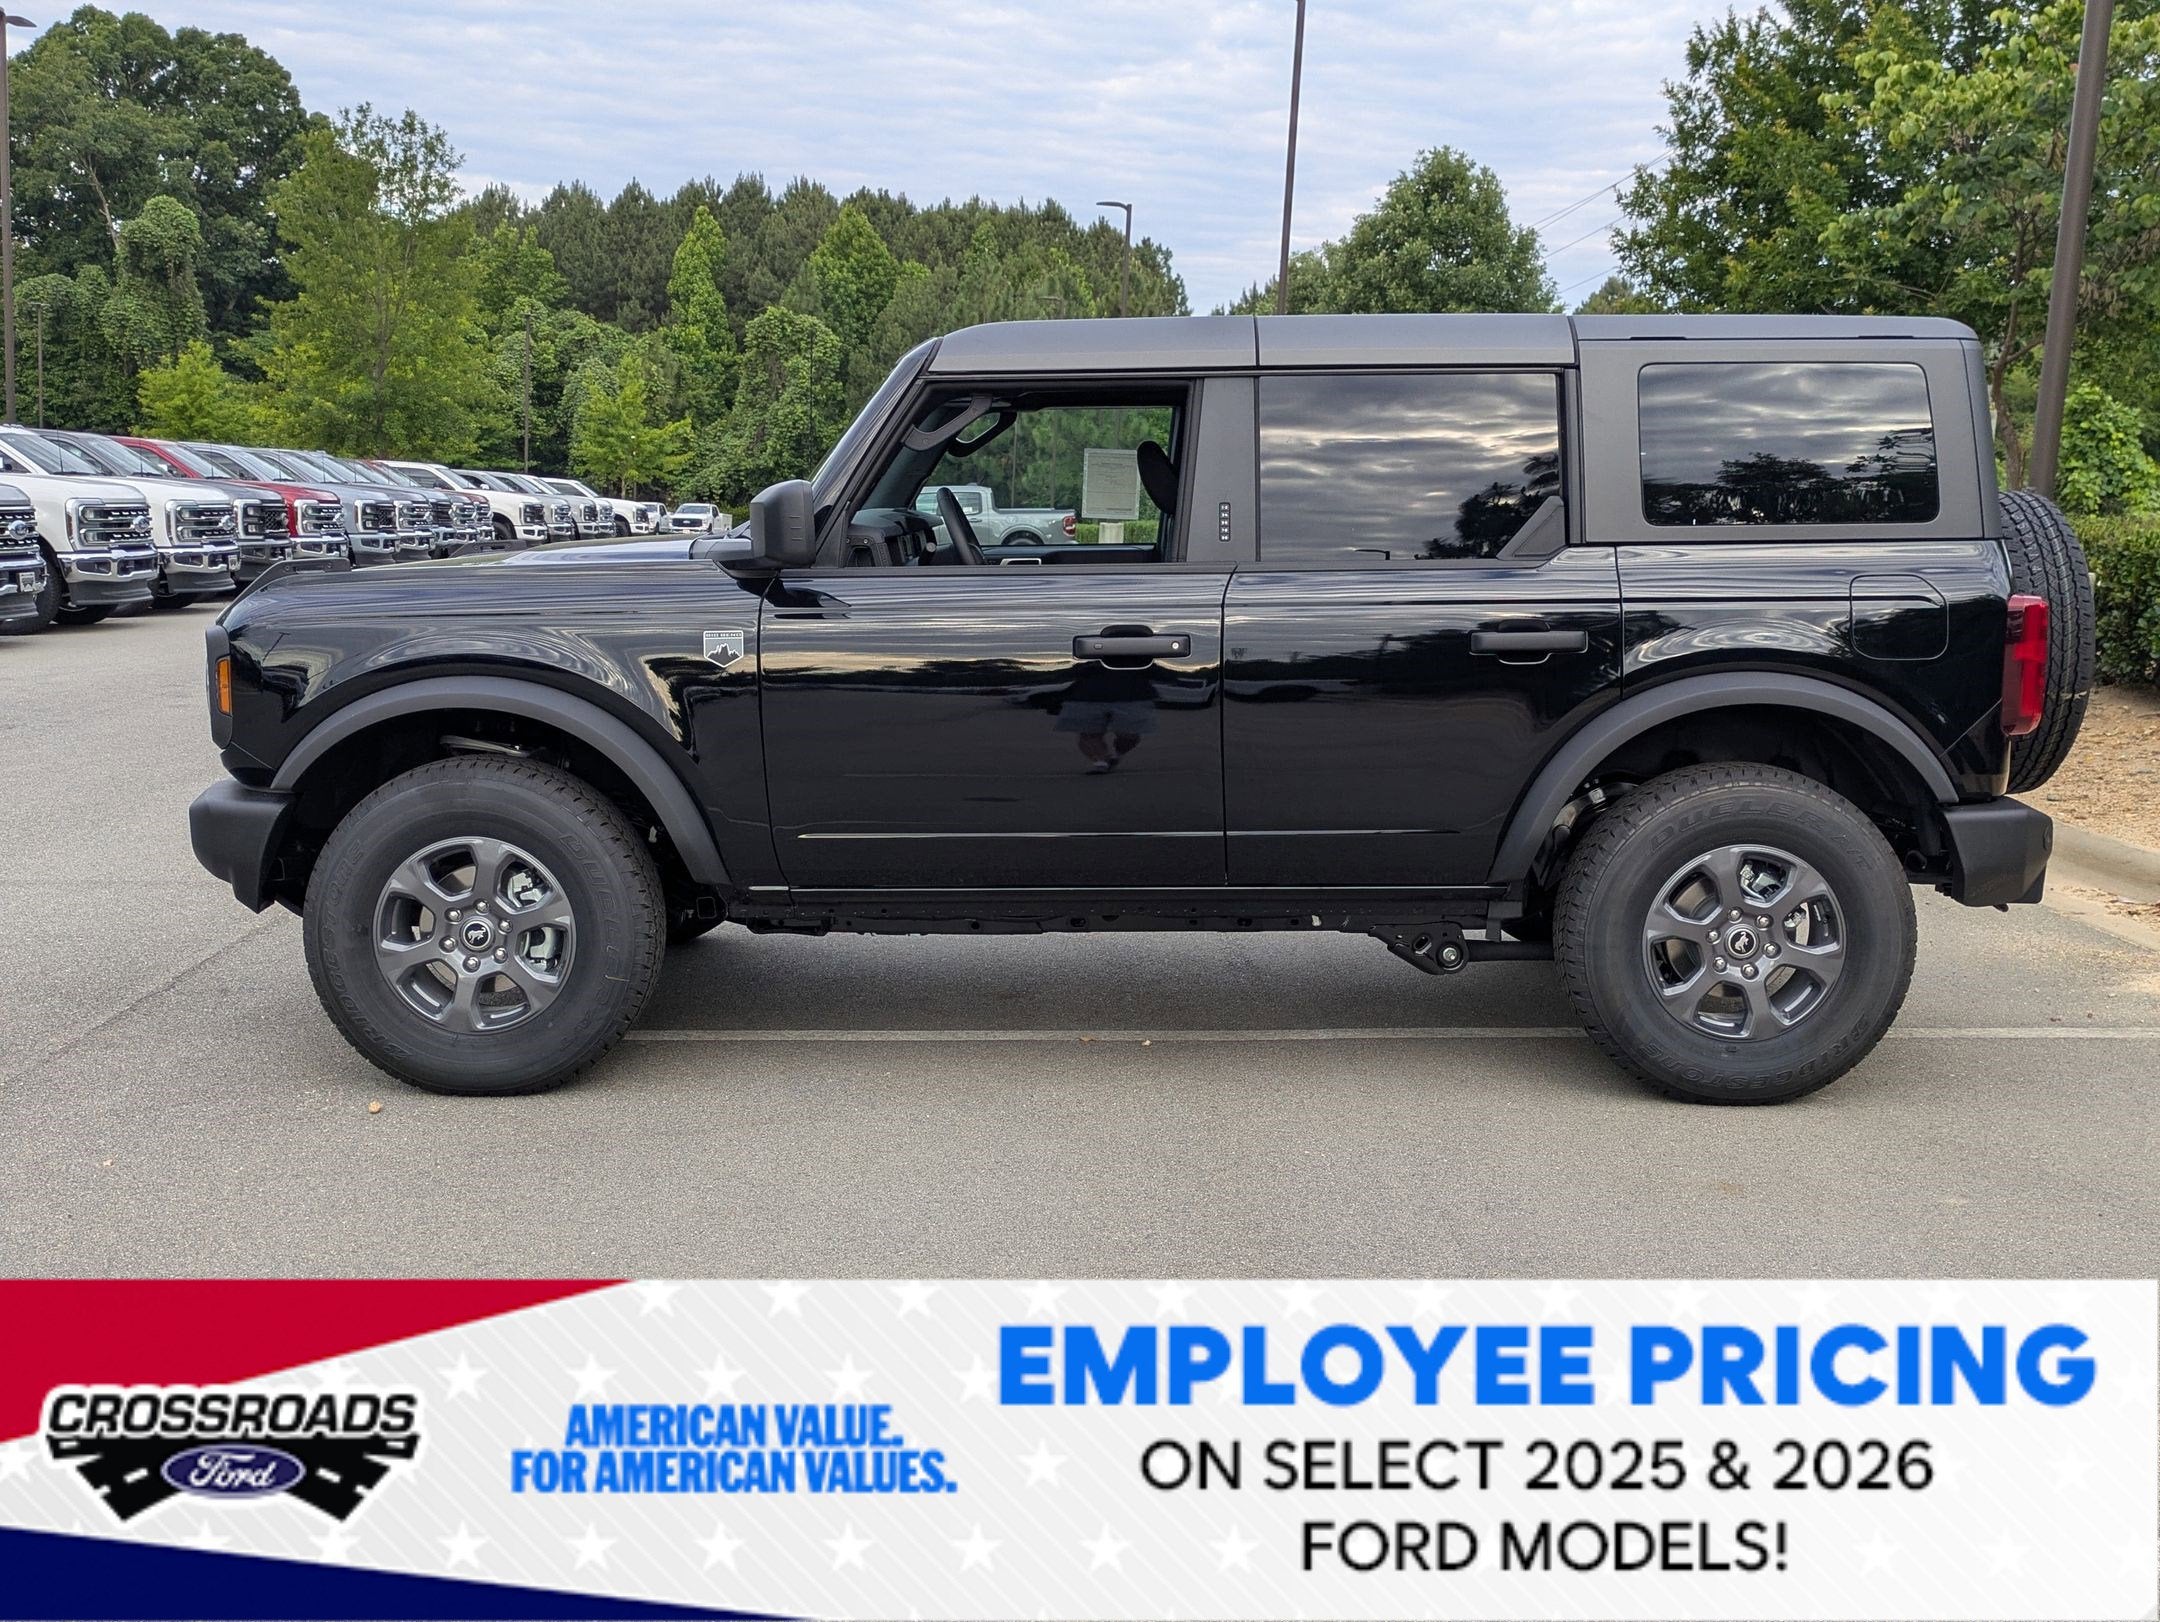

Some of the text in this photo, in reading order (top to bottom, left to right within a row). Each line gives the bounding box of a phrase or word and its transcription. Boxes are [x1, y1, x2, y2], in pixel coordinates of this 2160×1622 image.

[1649, 800, 1827, 856] DUELER
[321, 838, 413, 1060] BRIDGESTONE
[1640, 1014, 1868, 1090] BRIDGESTONE
